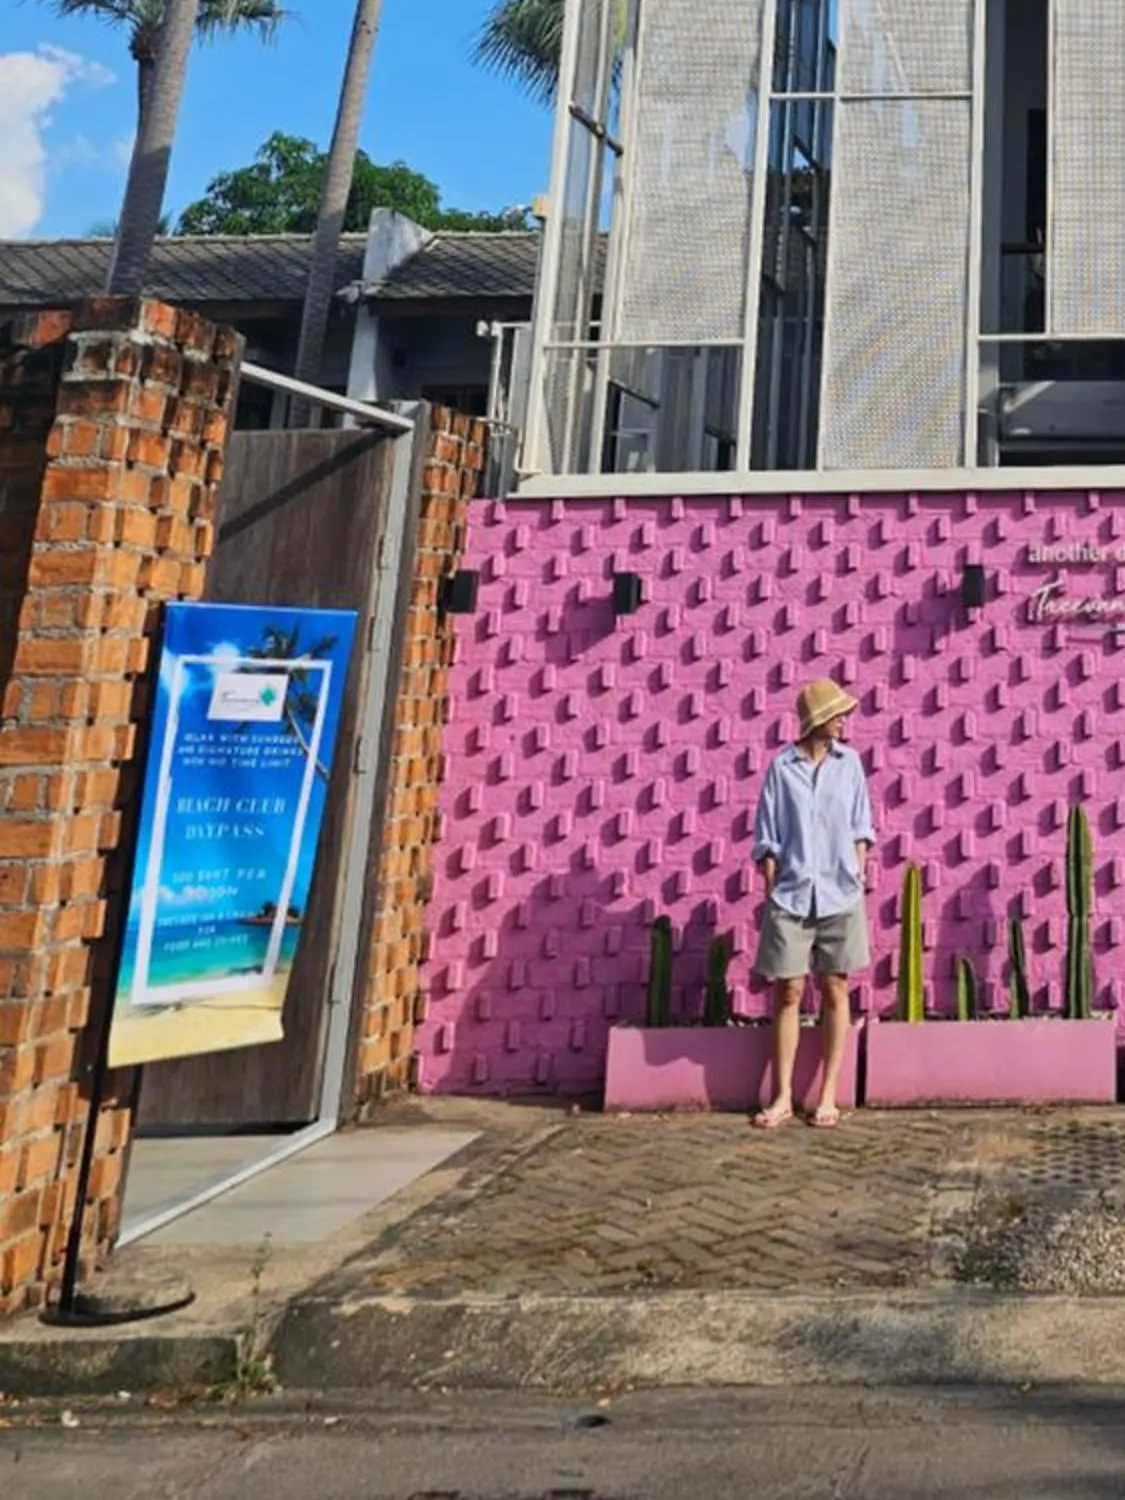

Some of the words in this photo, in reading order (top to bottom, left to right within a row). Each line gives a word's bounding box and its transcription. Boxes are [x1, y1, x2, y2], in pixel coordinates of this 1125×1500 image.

[176, 797, 230, 814] BEACH
[235, 797, 286, 814] CLUB
[185, 822, 264, 840] DAYPASS
[237, 866, 267, 880] PER
